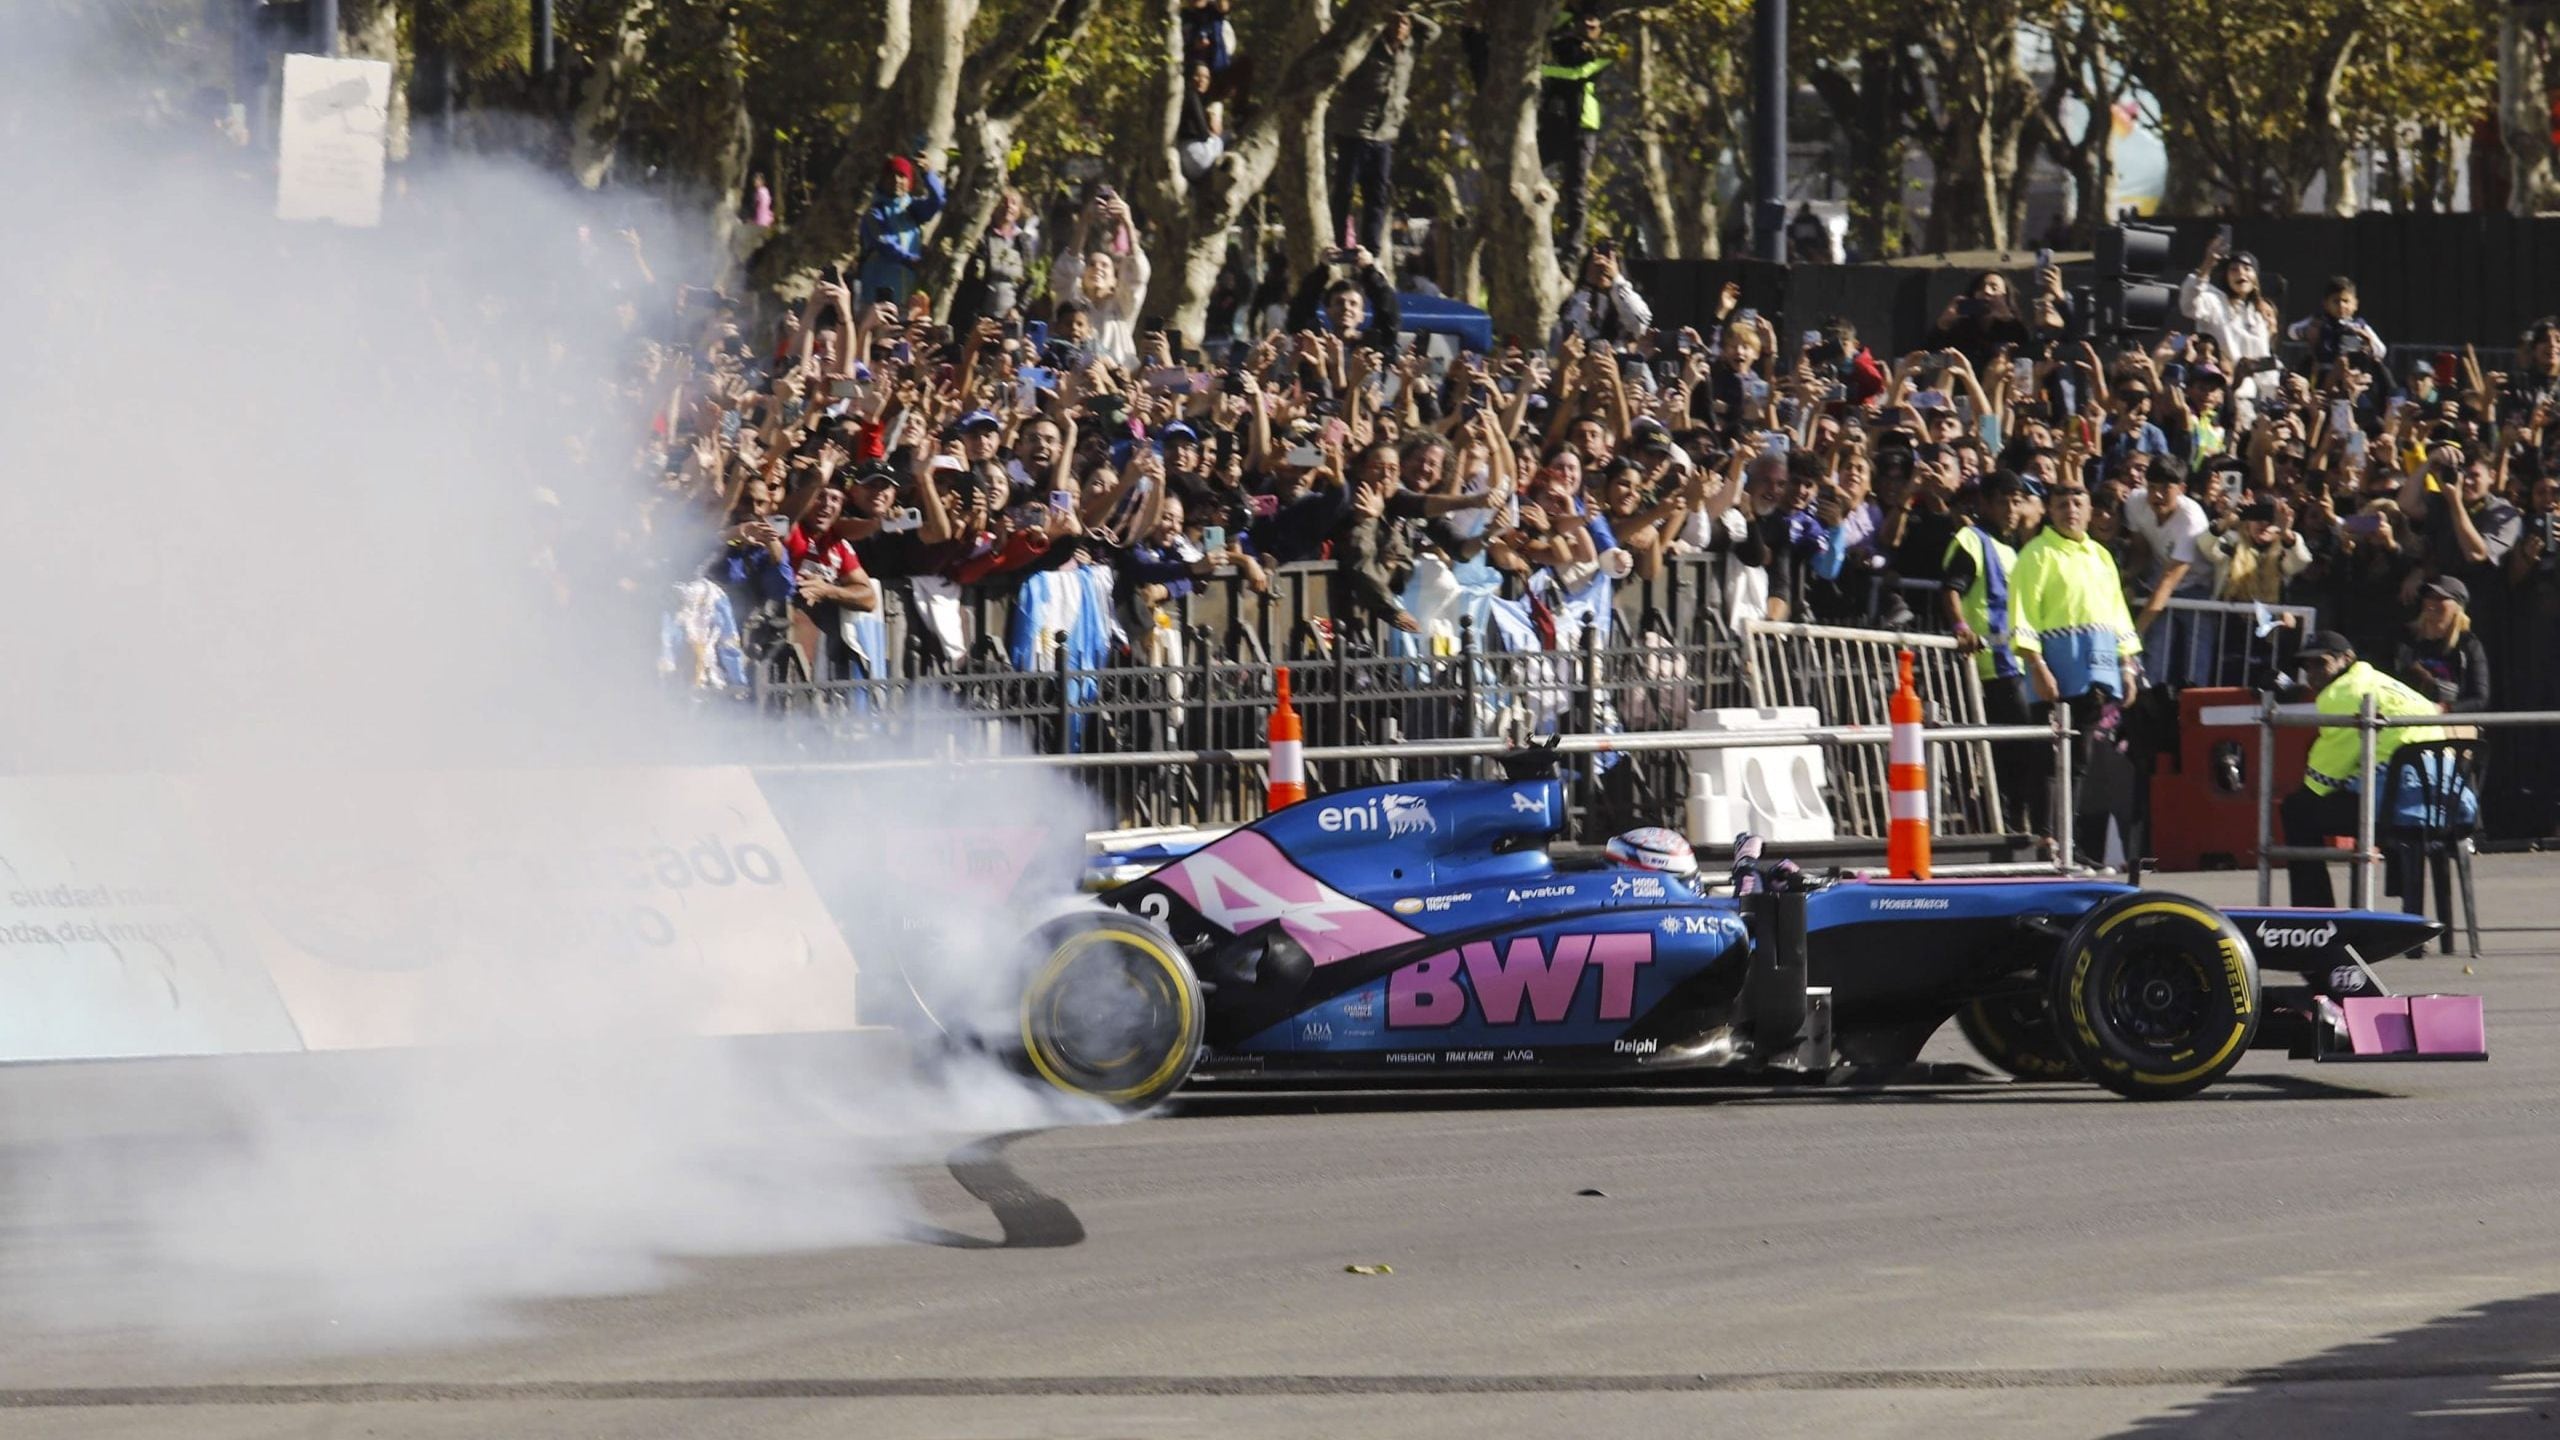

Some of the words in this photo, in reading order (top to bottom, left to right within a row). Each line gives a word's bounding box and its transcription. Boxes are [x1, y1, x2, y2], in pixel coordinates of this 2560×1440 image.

[1317, 799, 1379, 832] eni
[1426, 892, 1473, 905] mercado
[1521, 885, 1576, 900] avature
[1684, 915, 1746, 936] MSC
[1388, 932, 1653, 1028] BWT
[2217, 937, 2252, 1015] PIRELLI
[1467, 1050, 1494, 1061] RACER
[1614, 1038, 1658, 1056] Delphi
[1386, 1053, 1436, 1063] MISSION
